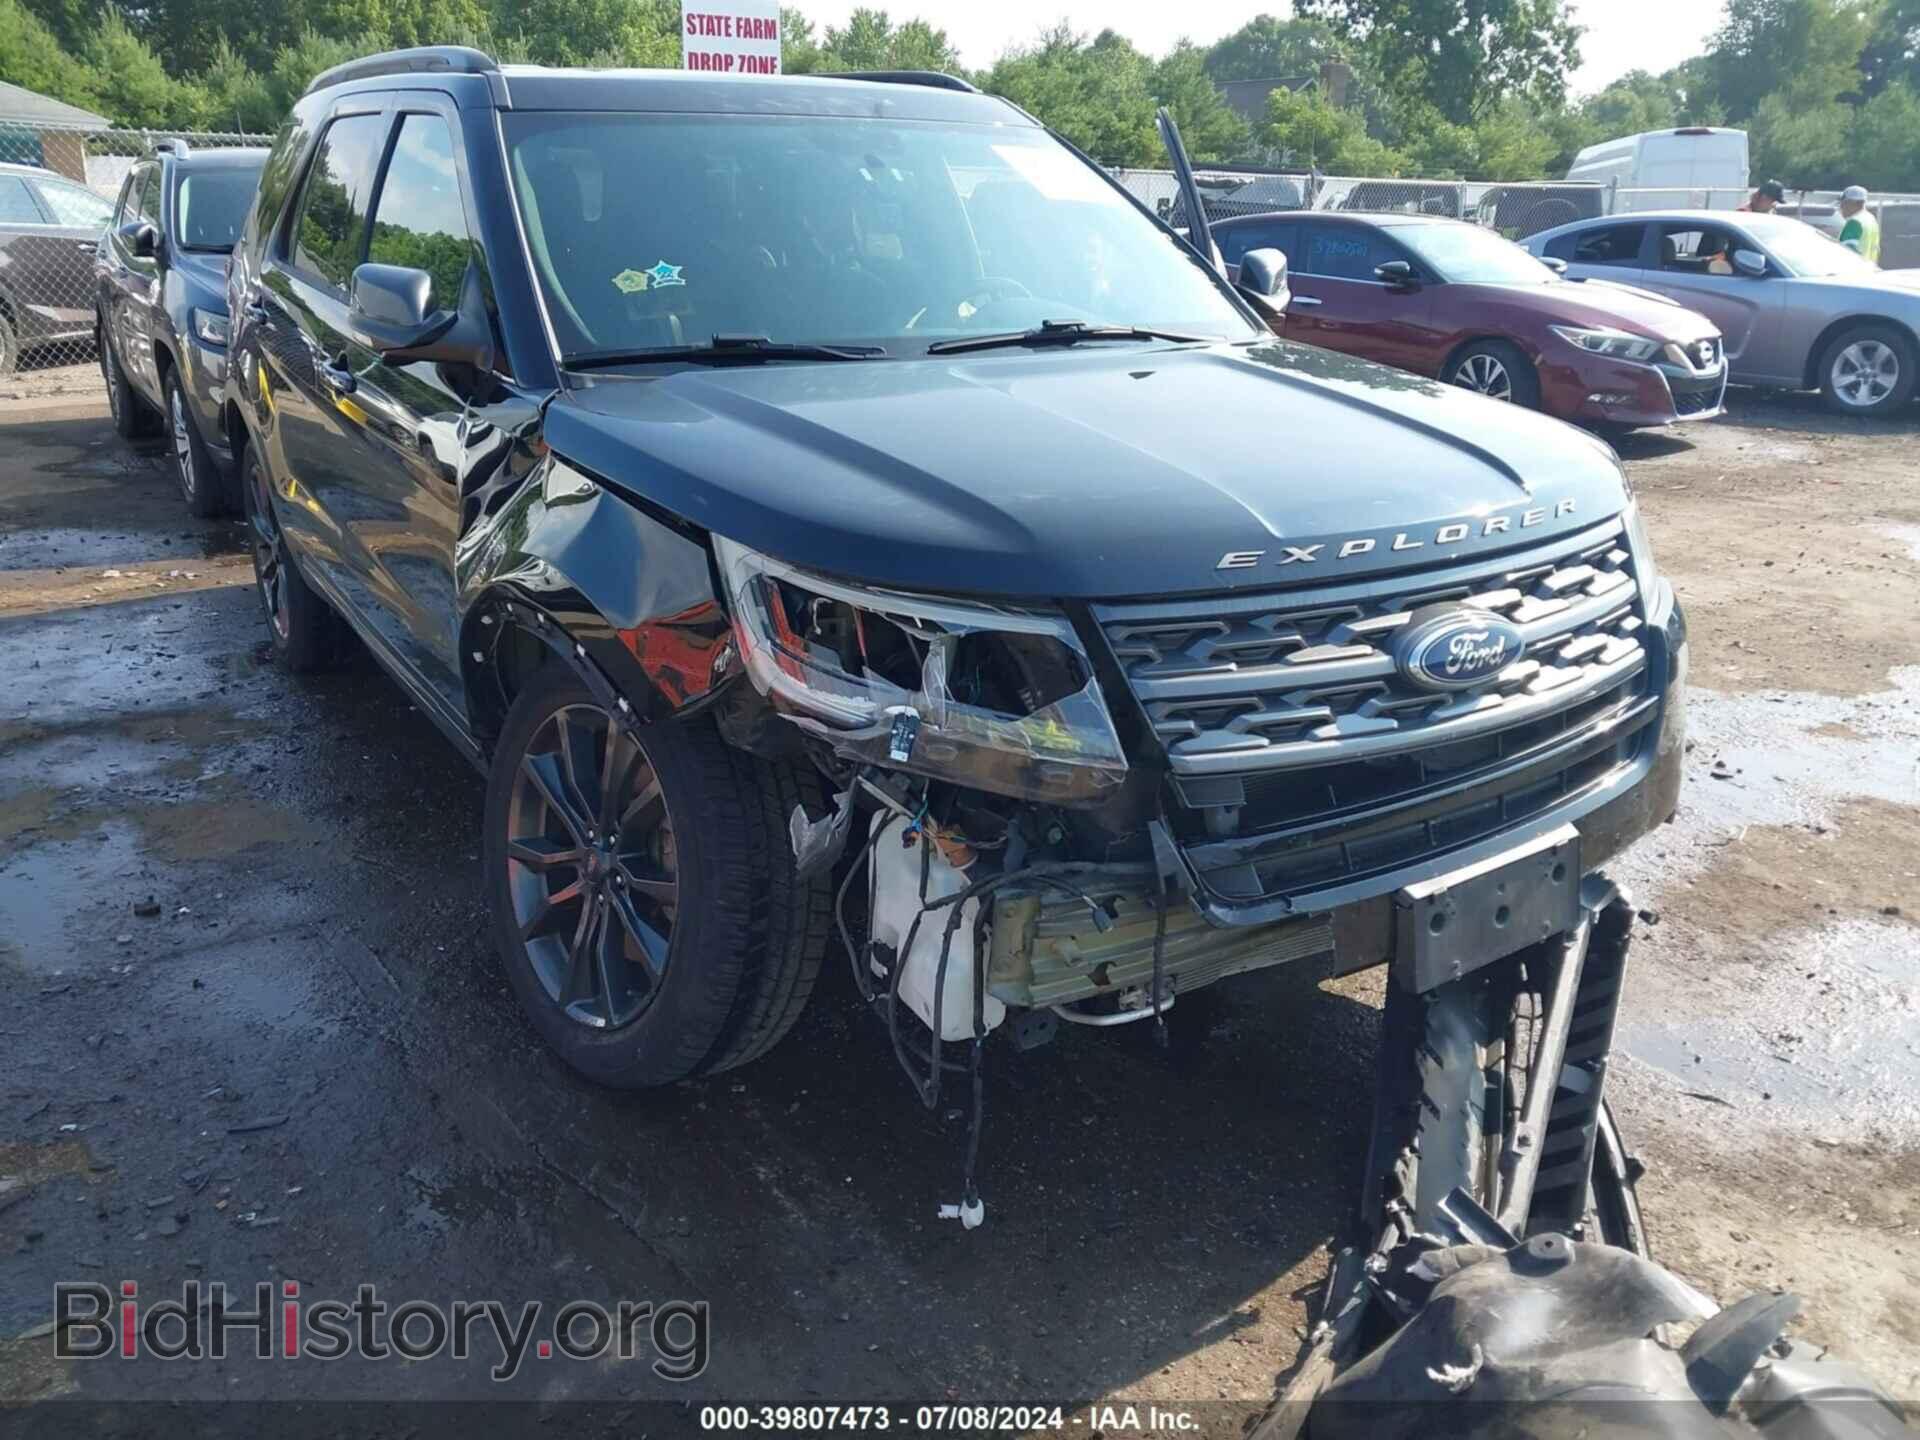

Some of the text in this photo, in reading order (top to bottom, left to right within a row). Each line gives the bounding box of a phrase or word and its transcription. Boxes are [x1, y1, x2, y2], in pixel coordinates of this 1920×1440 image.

[687, 13, 777, 40] STATE FARM
[688, 51, 778, 75] DROP ZONE
[1215, 498, 1576, 569] EXPLORER
[1445, 631, 1505, 674] Ford
